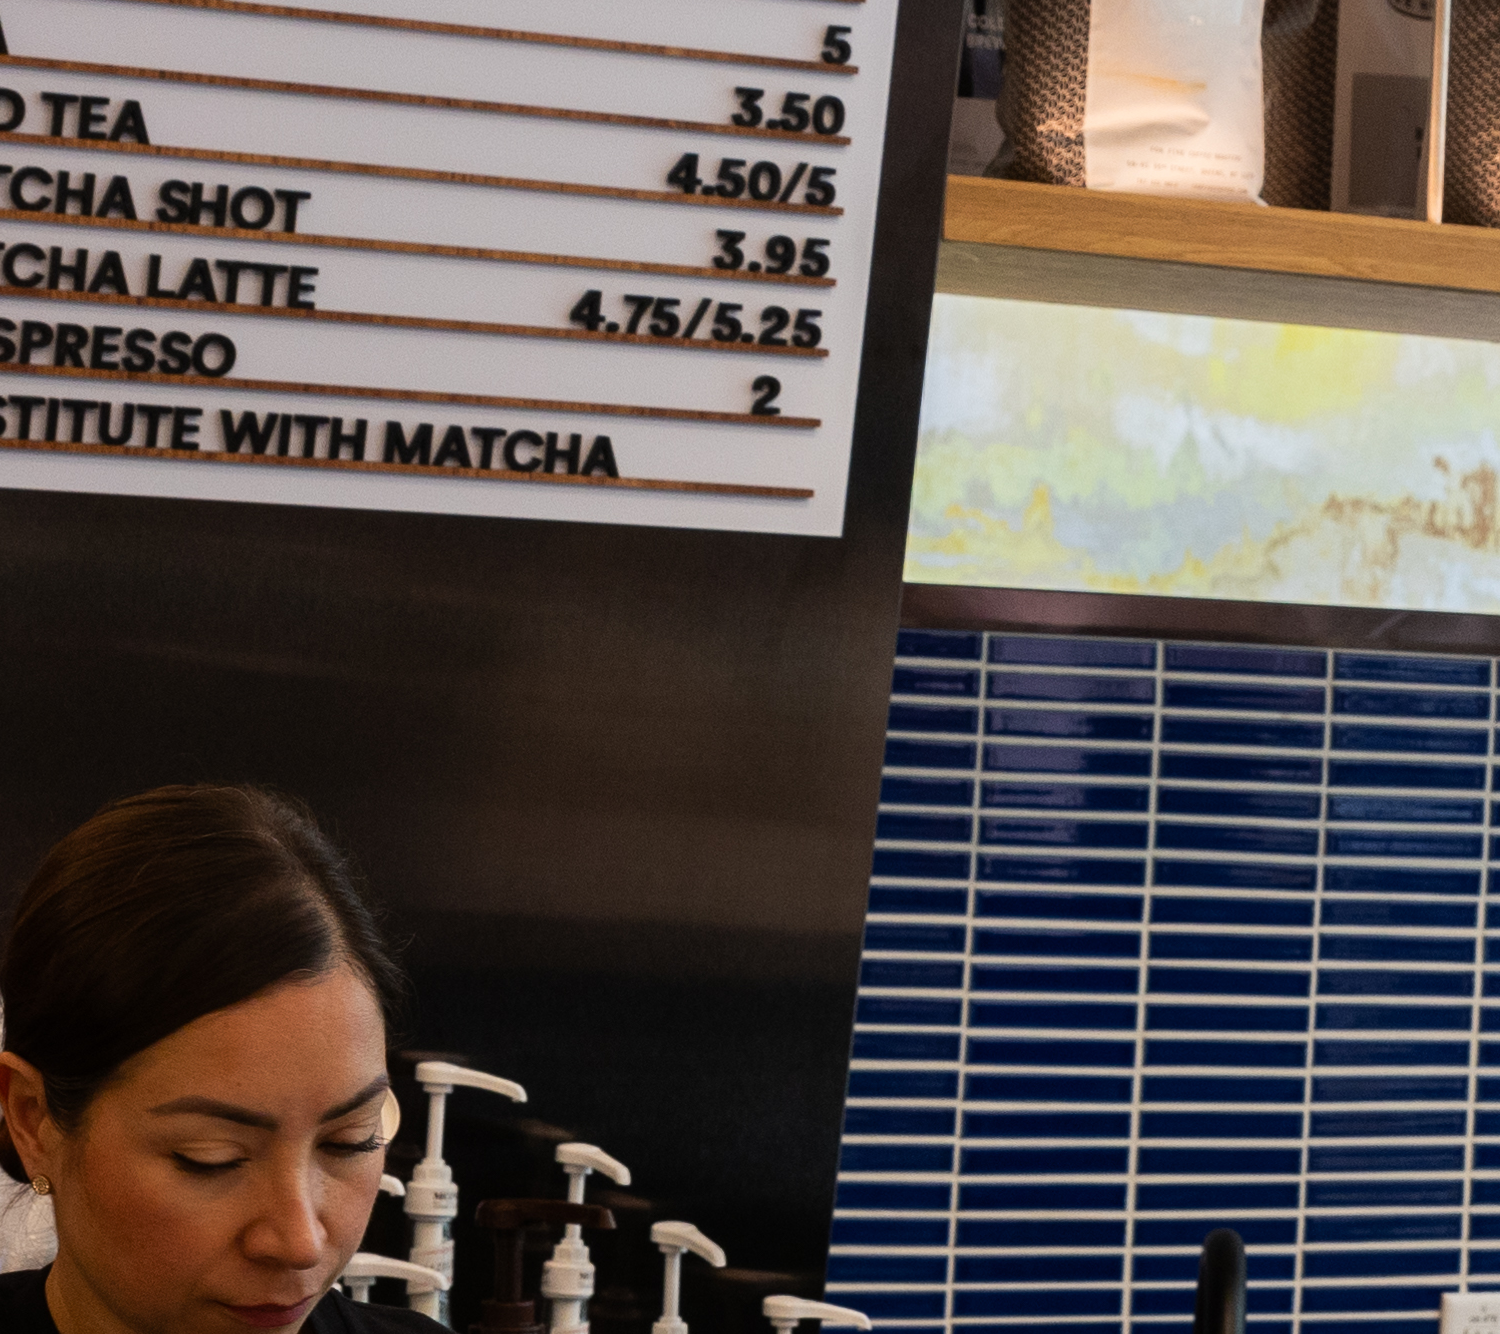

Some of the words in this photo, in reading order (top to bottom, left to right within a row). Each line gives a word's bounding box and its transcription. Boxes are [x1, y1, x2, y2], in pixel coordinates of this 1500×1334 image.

[819, 24, 853, 67] 5
[730, 85, 847, 138] 3.50
[39, 90, 151, 147] TEA
[665, 151, 838, 209] 4.50/5
[154, 178, 313, 235] SHOT
[711, 228, 831, 280] 3.95
[144, 253, 320, 313] LATTE
[568, 288, 823, 351] 4.75/5.25
[749, 374, 782, 419] 2
[218, 408, 369, 464] WITH
[381, 419, 620, 481] MATCHA
